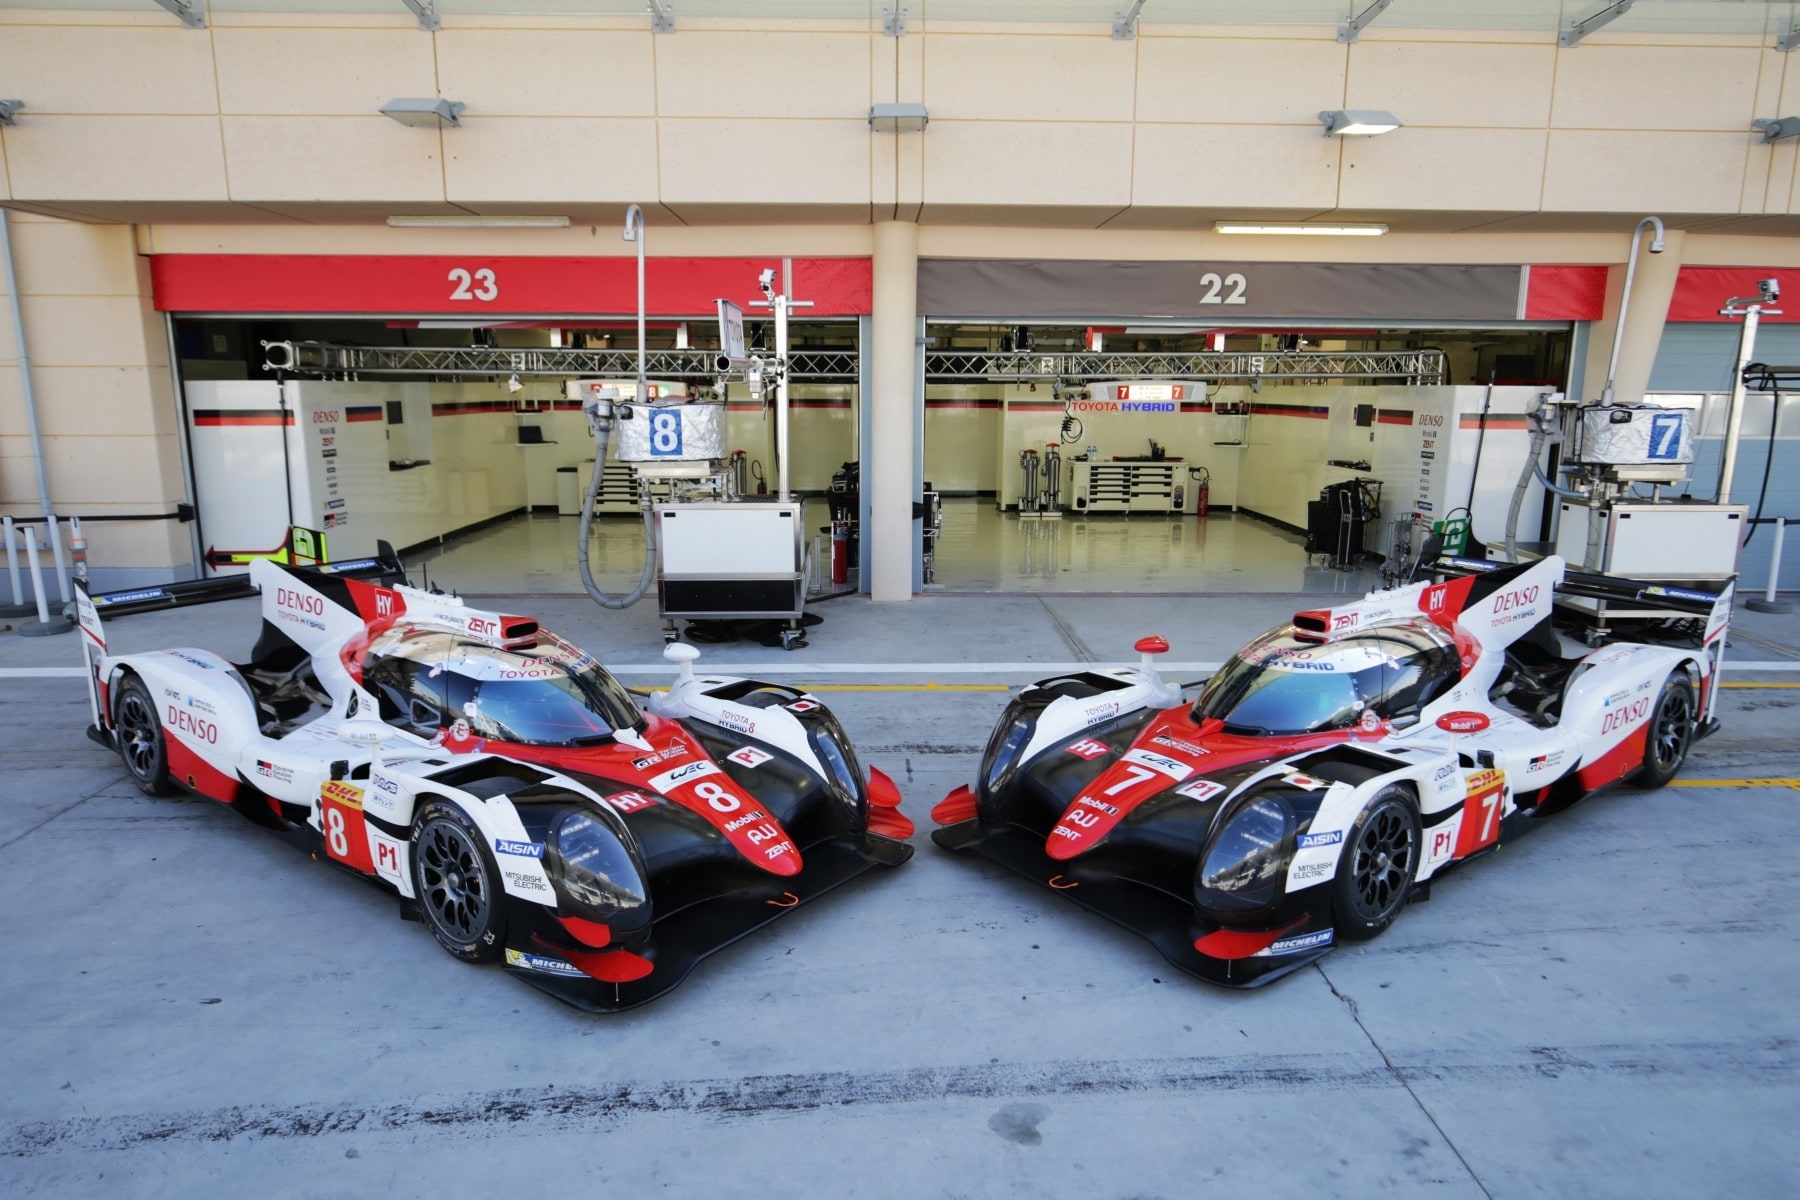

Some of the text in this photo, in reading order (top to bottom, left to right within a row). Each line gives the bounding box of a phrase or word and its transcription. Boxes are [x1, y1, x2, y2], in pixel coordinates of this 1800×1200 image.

[448, 267, 498, 301] 23
[1199, 273, 1247, 304] 22
[648, 387, 656, 398] 8
[1119, 386, 1127, 399] 7
[1174, 386, 1181, 399] 7
[1072, 402, 1175, 412] TOYOTA HYBRID
[313, 410, 339, 423] DENSO
[1419, 414, 1444, 427] DENSO
[653, 413, 678, 452] 8
[1656, 418, 1680, 456] 7
[111, 591, 161, 603] MICHELIN
[277, 587, 324, 616] DENSO
[376, 594, 392, 616] HY
[1430, 589, 1446, 611] HY
[1493, 585, 1539, 614] DENSO
[468, 616, 497, 636] ZENT
[1333, 612, 1359, 630] ZENT
[499, 669, 561, 679] TOYOTA
[1085, 702, 1120, 716] TOYOTA 7
[1601, 697, 1649, 735] DENSO
[168, 704, 217, 744] DENSO
[721, 710, 756, 734] TOYOTA 8
[1087, 710, 1115, 725] HYBRID
[719, 719, 748, 733] HYBRID
[1450, 722, 1469, 730] Mobil
[1070, 739, 1107, 756] HY
[636, 756, 661, 770] GR
[734, 748, 766, 764] P1
[1141, 754, 1183, 769] WEC
[256, 767, 272, 778] GR
[670, 762, 706, 780] WEC
[1526, 762, 1546, 773] GR
[1103, 765, 1157, 796] 7
[1470, 769, 1498, 788] DHL
[326, 782, 358, 798] DHL
[694, 782, 741, 812] 8
[1184, 782, 1218, 797] P1
[610, 793, 649, 810] HY
[1079, 796, 1107, 811] Mobil
[724, 812, 756, 832] Mobil
[1480, 792, 1500, 842] 7
[328, 807, 348, 856] 8
[1053, 825, 1081, 841] ZENT
[1301, 832, 1341, 847] AISIN
[498, 841, 541, 856] AISIN
[765, 841, 792, 860] ZENT
[1434, 831, 1451, 857] P1
[378, 842, 397, 871] P1
[1293, 870, 1325, 879] ELECTRIC
[1298, 862, 1333, 872] MITSUBISHI
[505, 871, 543, 884] MITSUBISHI
[513, 880, 547, 891] ELECTRIC
[1271, 932, 1331, 949] MICHELIN
[532, 958, 579, 971] MICHE
